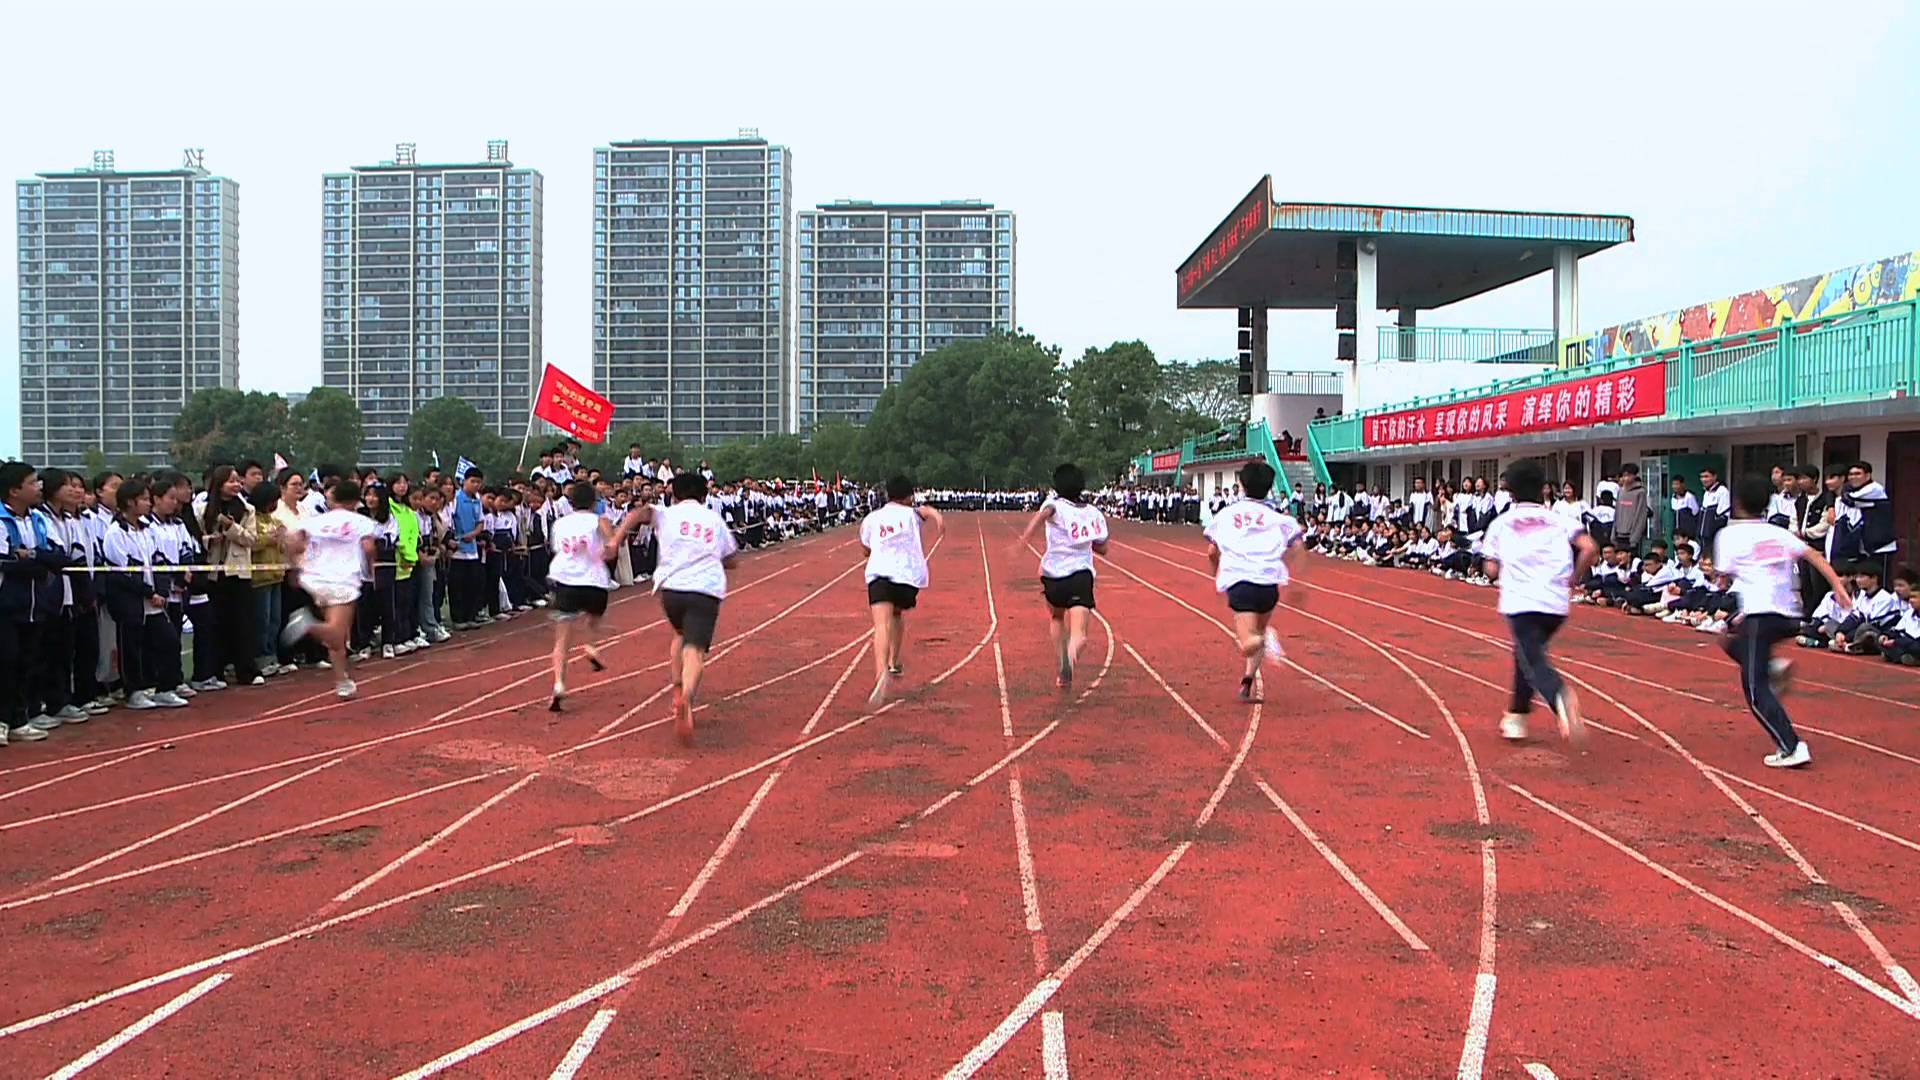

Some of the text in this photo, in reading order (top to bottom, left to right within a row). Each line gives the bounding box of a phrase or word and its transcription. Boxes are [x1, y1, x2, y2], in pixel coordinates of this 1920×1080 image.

[1372, 375, 1636, 442] 留下你的汗水 呈现你的风采 演绎你的精彩
